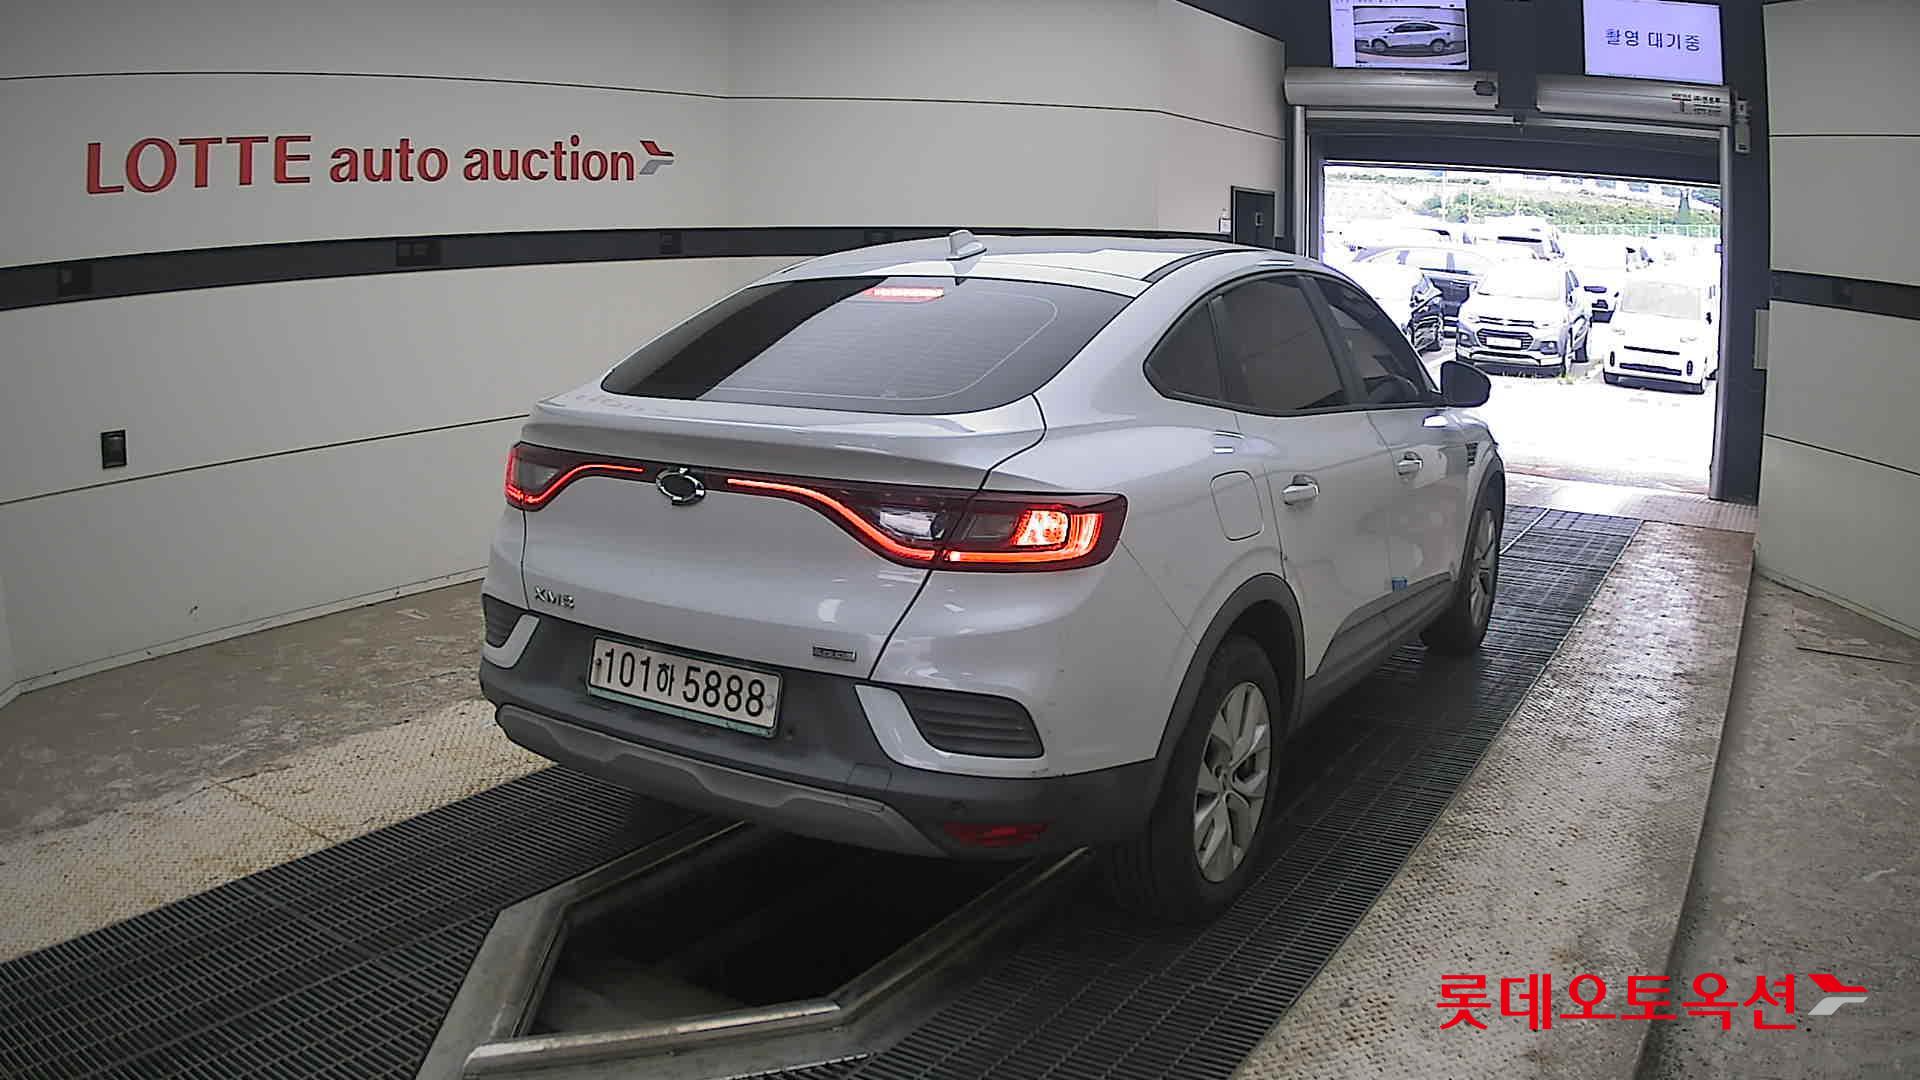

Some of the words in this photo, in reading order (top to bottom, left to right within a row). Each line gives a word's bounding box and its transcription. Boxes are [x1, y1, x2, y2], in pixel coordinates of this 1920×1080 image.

[1605, 28, 1640, 47] 촬영
[1647, 32, 1701, 52] 대기중
[86, 135, 312, 195] LOTTE
[329, 138, 449, 183] auto
[463, 134, 635, 183] auction
[682, 665, 766, 717] 5888
